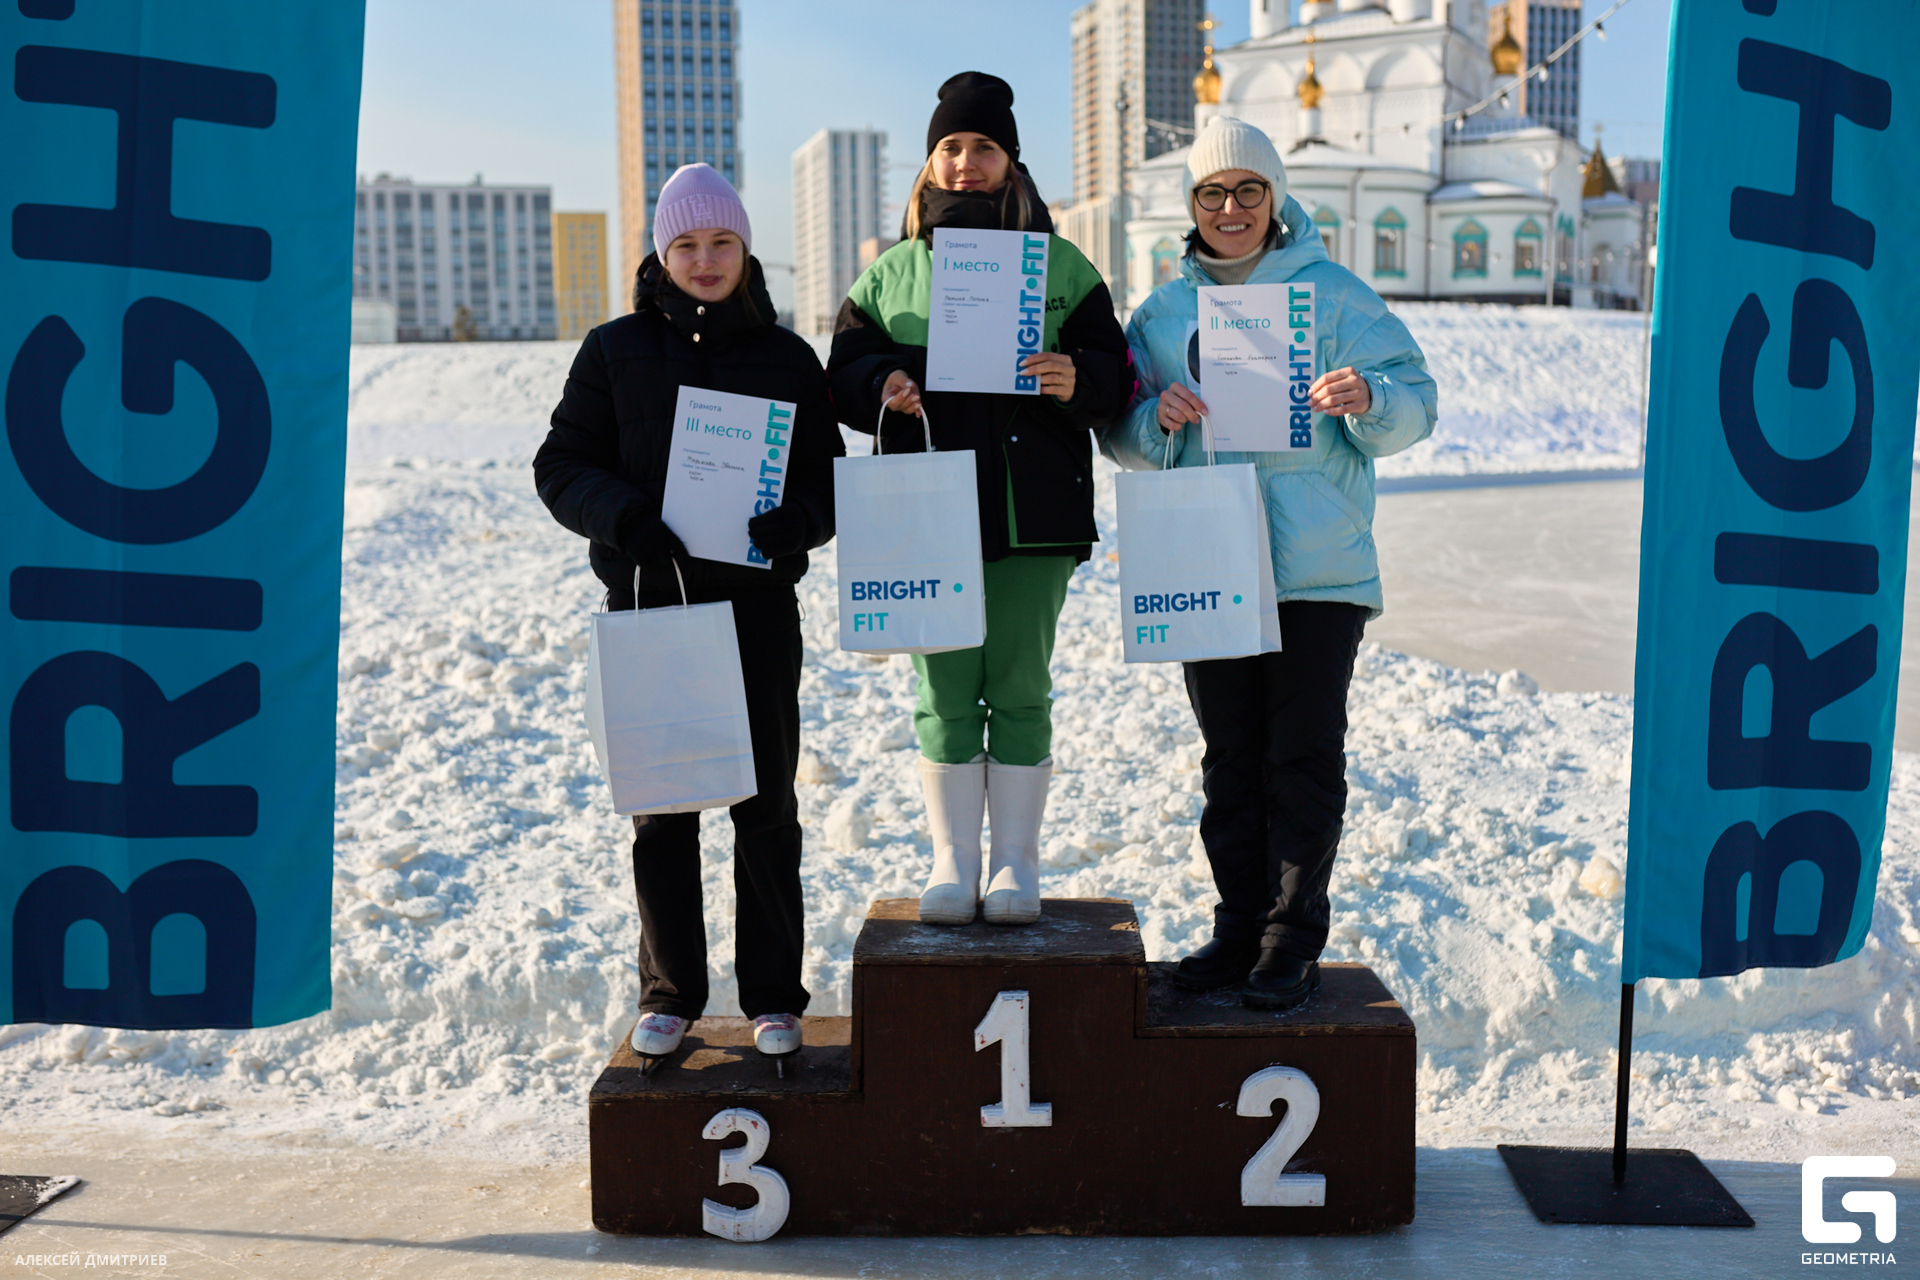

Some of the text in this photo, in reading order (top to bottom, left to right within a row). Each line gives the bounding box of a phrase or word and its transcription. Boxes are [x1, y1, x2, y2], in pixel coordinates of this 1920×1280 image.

[945, 240, 978, 249] Грамота
[953, 260, 1000, 273] место
[1210, 299, 1243, 307] Грамота
[1211, 316, 1271, 330] II место
[689, 400, 722, 412] Грамота
[686, 417, 752, 440] III место
[1700, 0, 1892, 977] BRIGH
[5, 0, 277, 1029] BRIGH
[851, 579, 941, 601] BRIGHT
[1134, 591, 1221, 614] BRIGHT
[854, 612, 889, 632] FIT
[1136, 624, 1170, 644] FIT
[974, 990, 1053, 1127] 1
[1236, 1066, 1327, 1207] 2
[702, 1107, 791, 1242] 3
